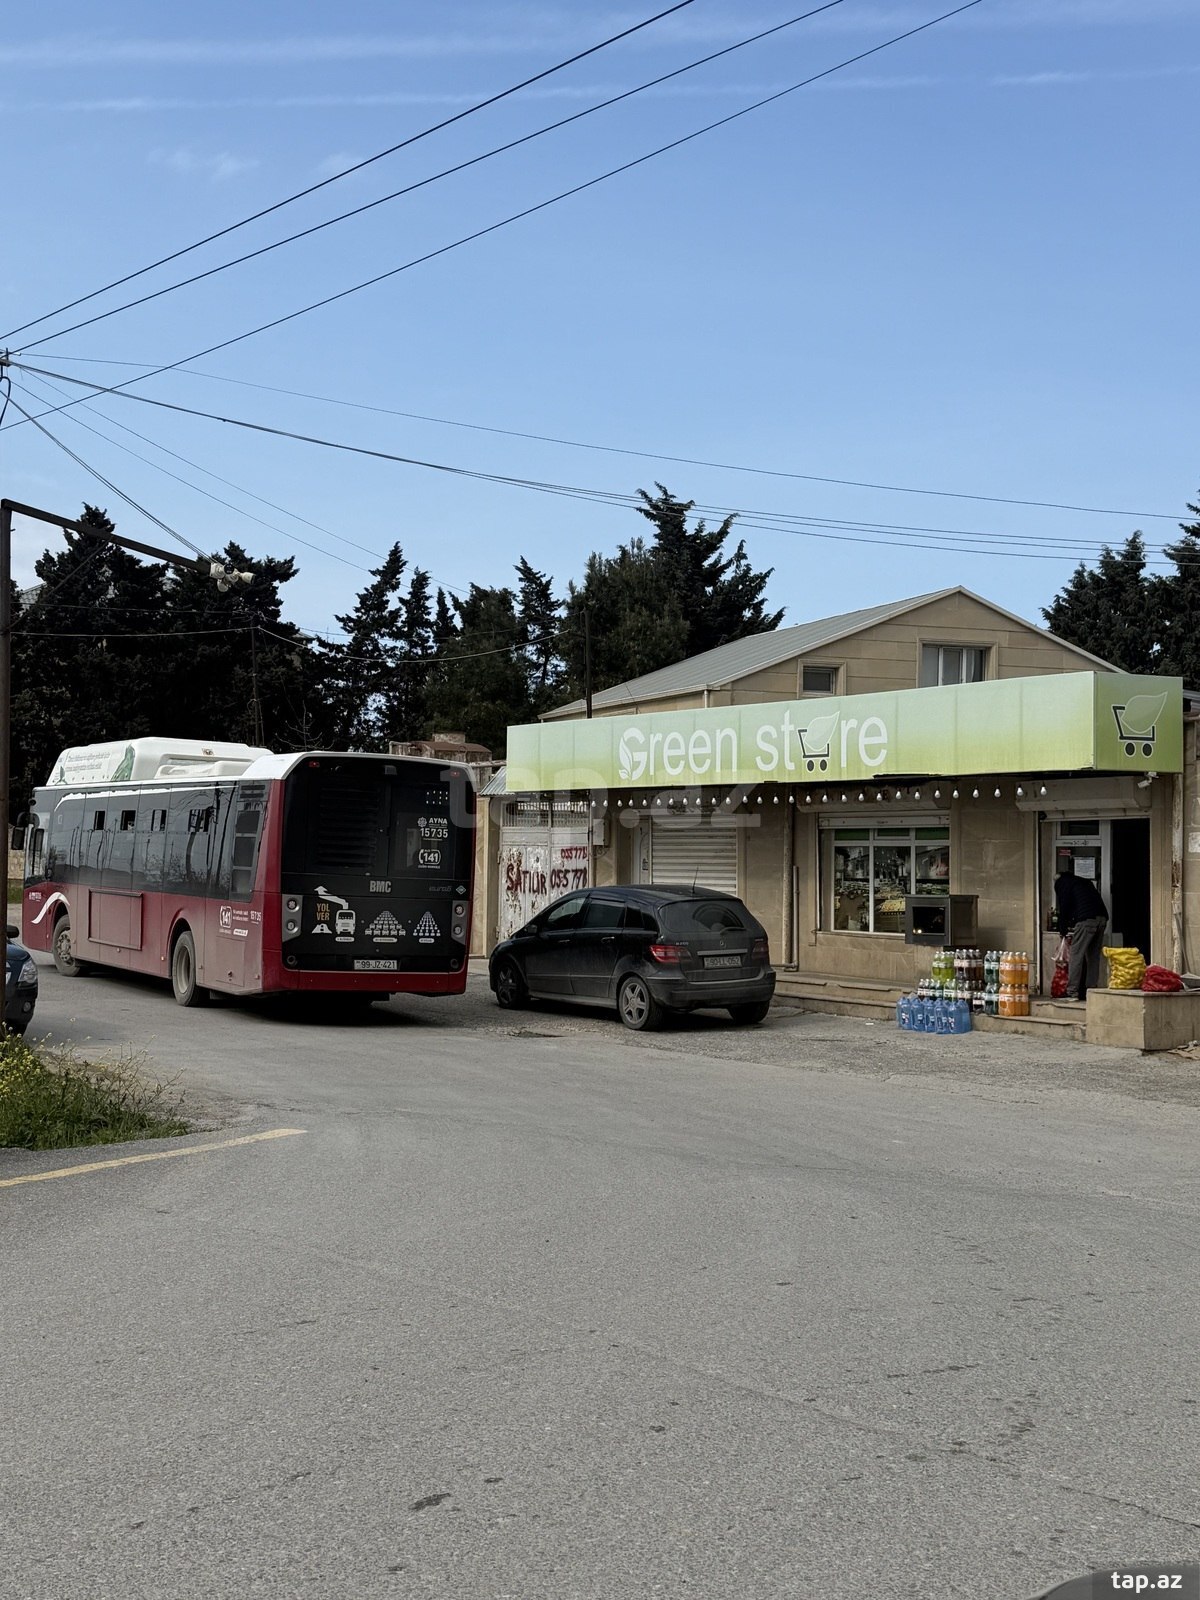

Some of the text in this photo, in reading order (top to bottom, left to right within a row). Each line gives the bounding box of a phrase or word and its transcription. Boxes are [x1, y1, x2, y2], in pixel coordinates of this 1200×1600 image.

[618, 726, 738, 781] Green
[420, 827, 449, 838] 15735
[423, 852, 439, 863] 141
[369, 880, 392, 893] BMC
[316, 903, 330, 912] YOL
[316, 912, 330, 921] VER
